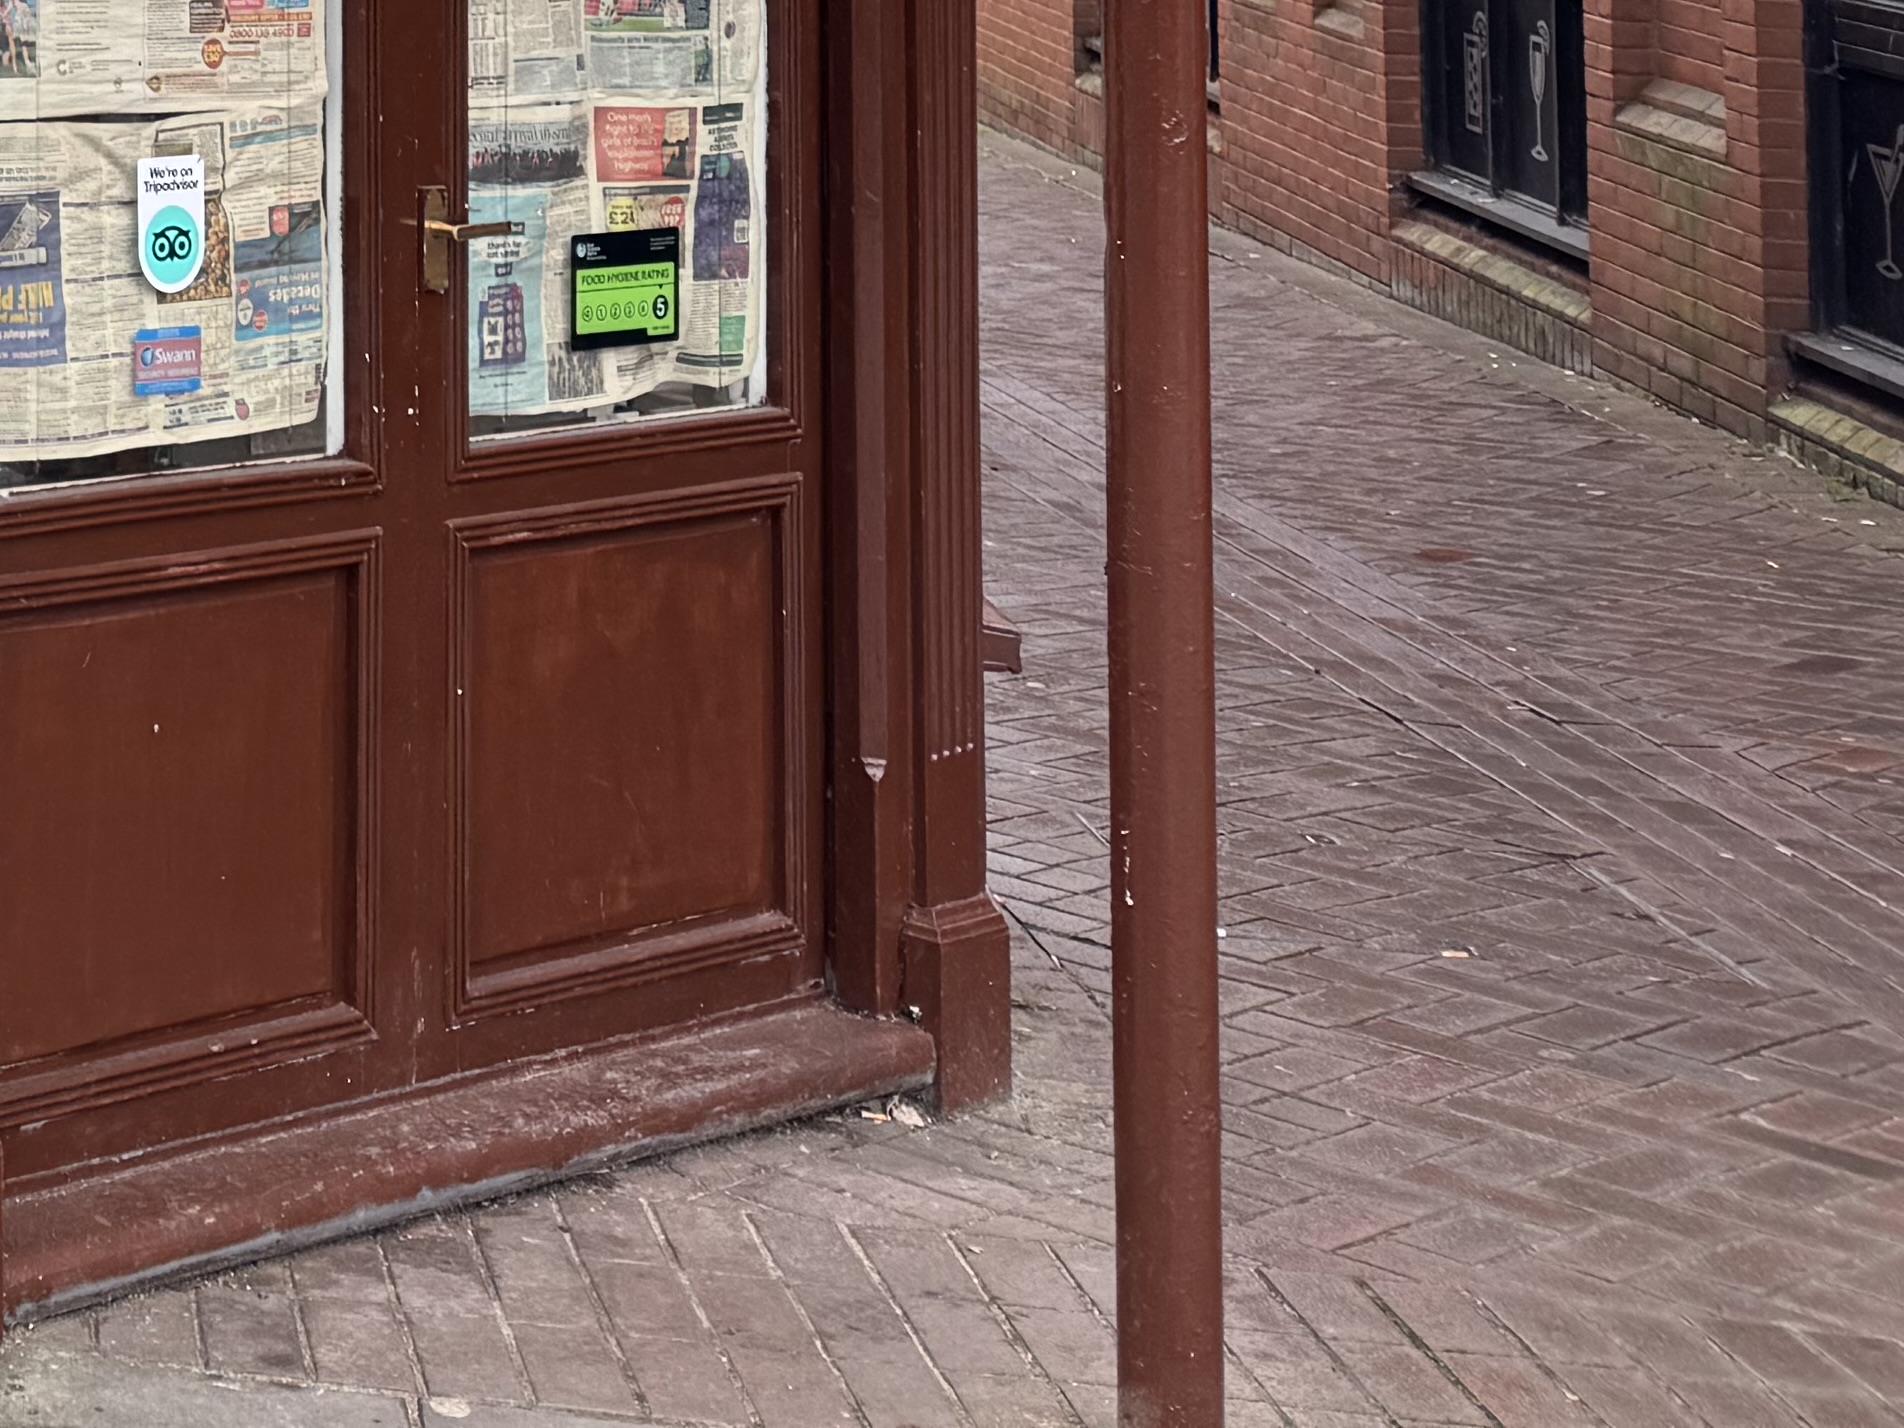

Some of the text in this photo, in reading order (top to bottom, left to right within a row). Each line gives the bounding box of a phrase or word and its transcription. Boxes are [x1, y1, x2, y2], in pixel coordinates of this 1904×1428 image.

[149, 166, 193, 178] We're on
[144, 179, 199, 195] Tripadvisor
[582, 269, 669, 286] FOOD HYGIENE RATING
[656, 298, 665, 317] 5
[155, 348, 196, 364] Swann
